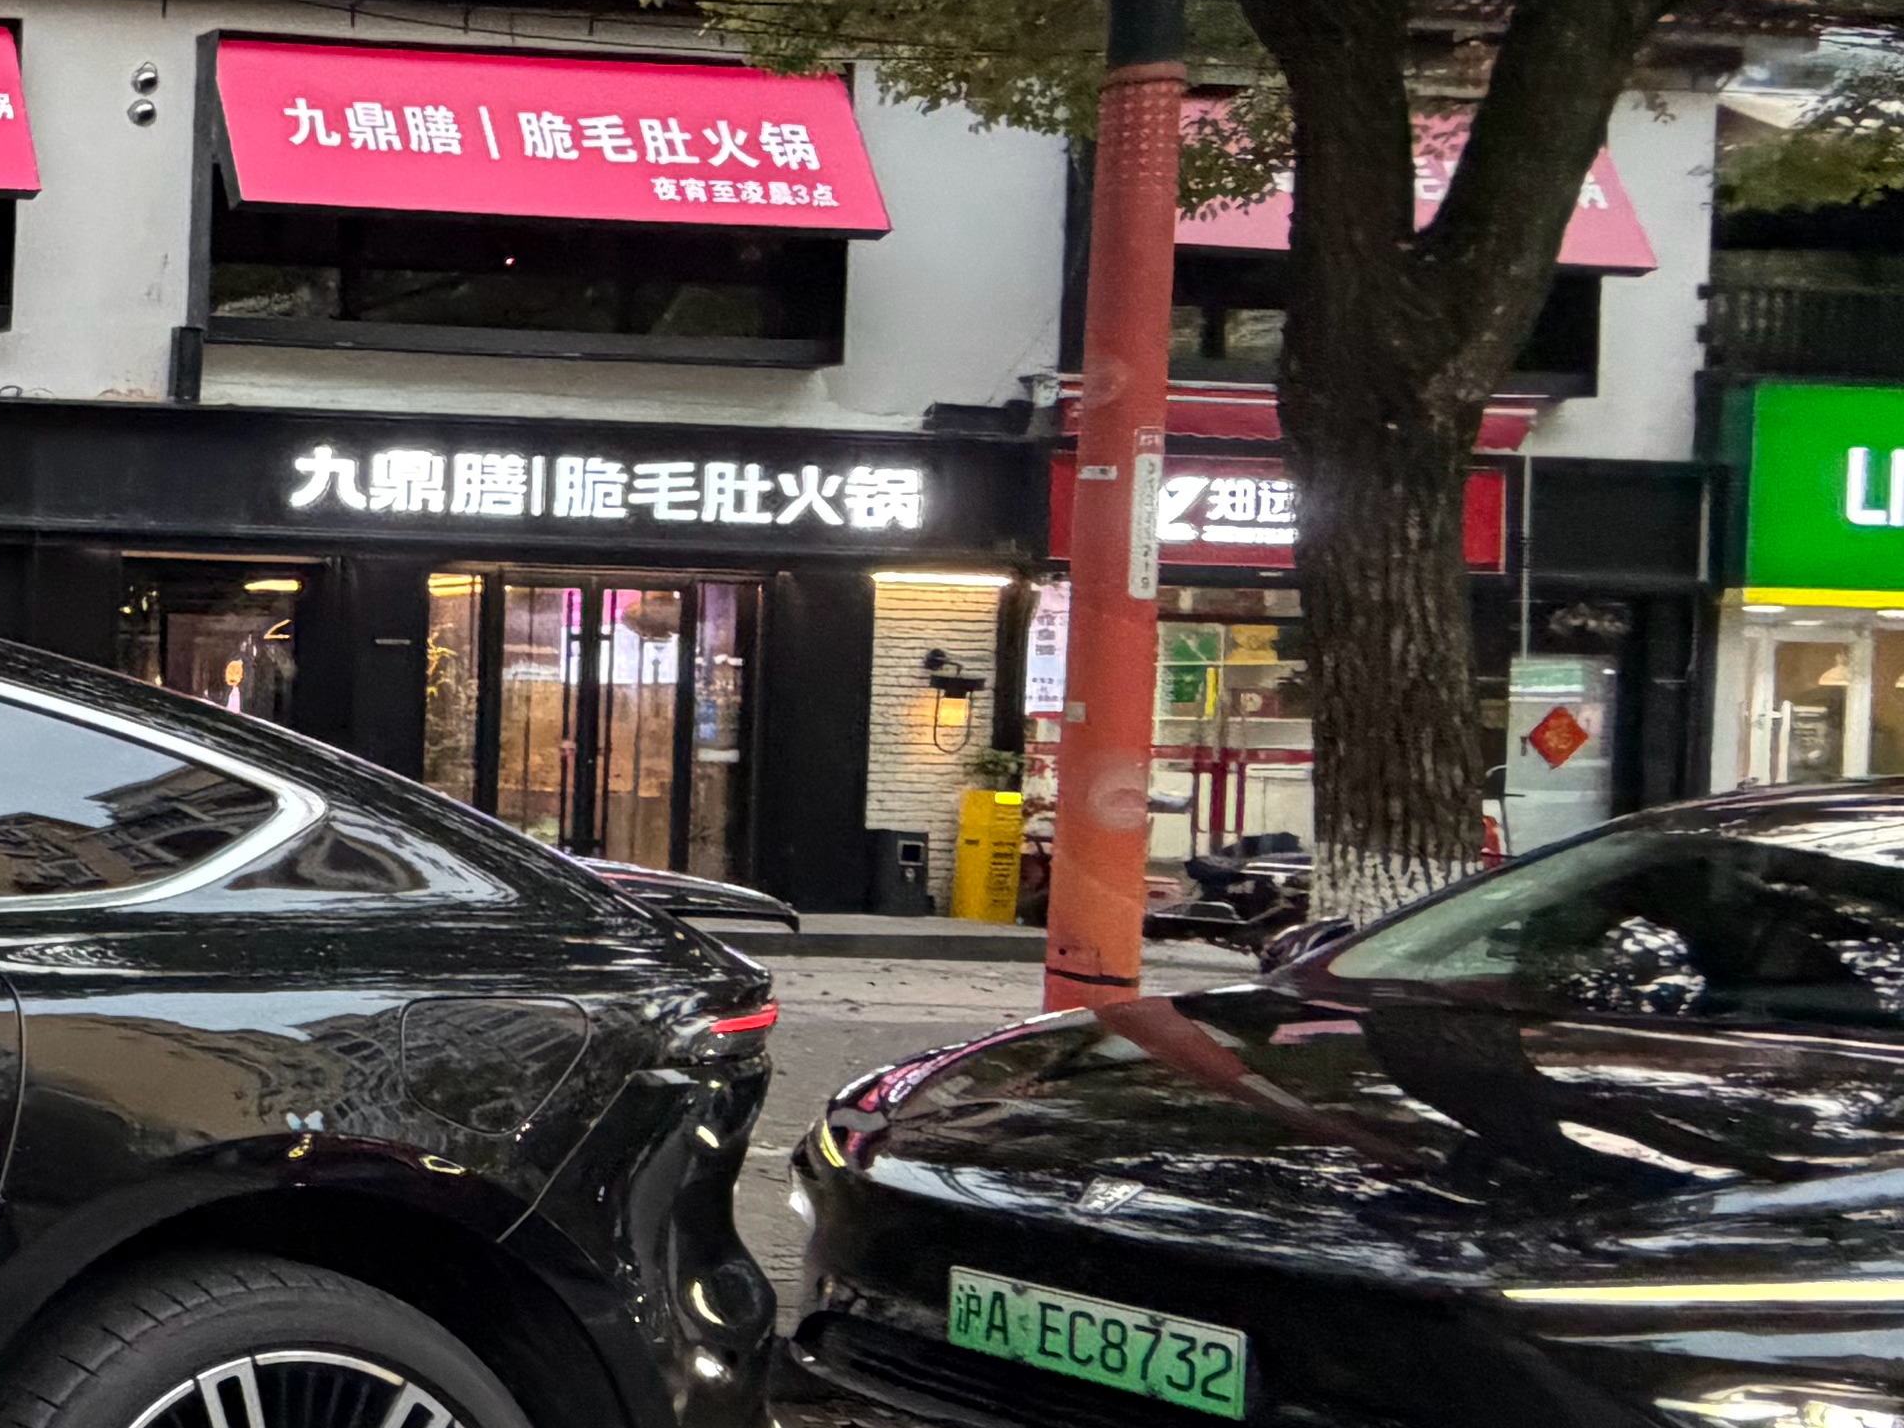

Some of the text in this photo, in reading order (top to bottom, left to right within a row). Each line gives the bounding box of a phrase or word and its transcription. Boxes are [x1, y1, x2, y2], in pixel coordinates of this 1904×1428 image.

[650, 175, 840, 208] 夜宵至凌晨3点
